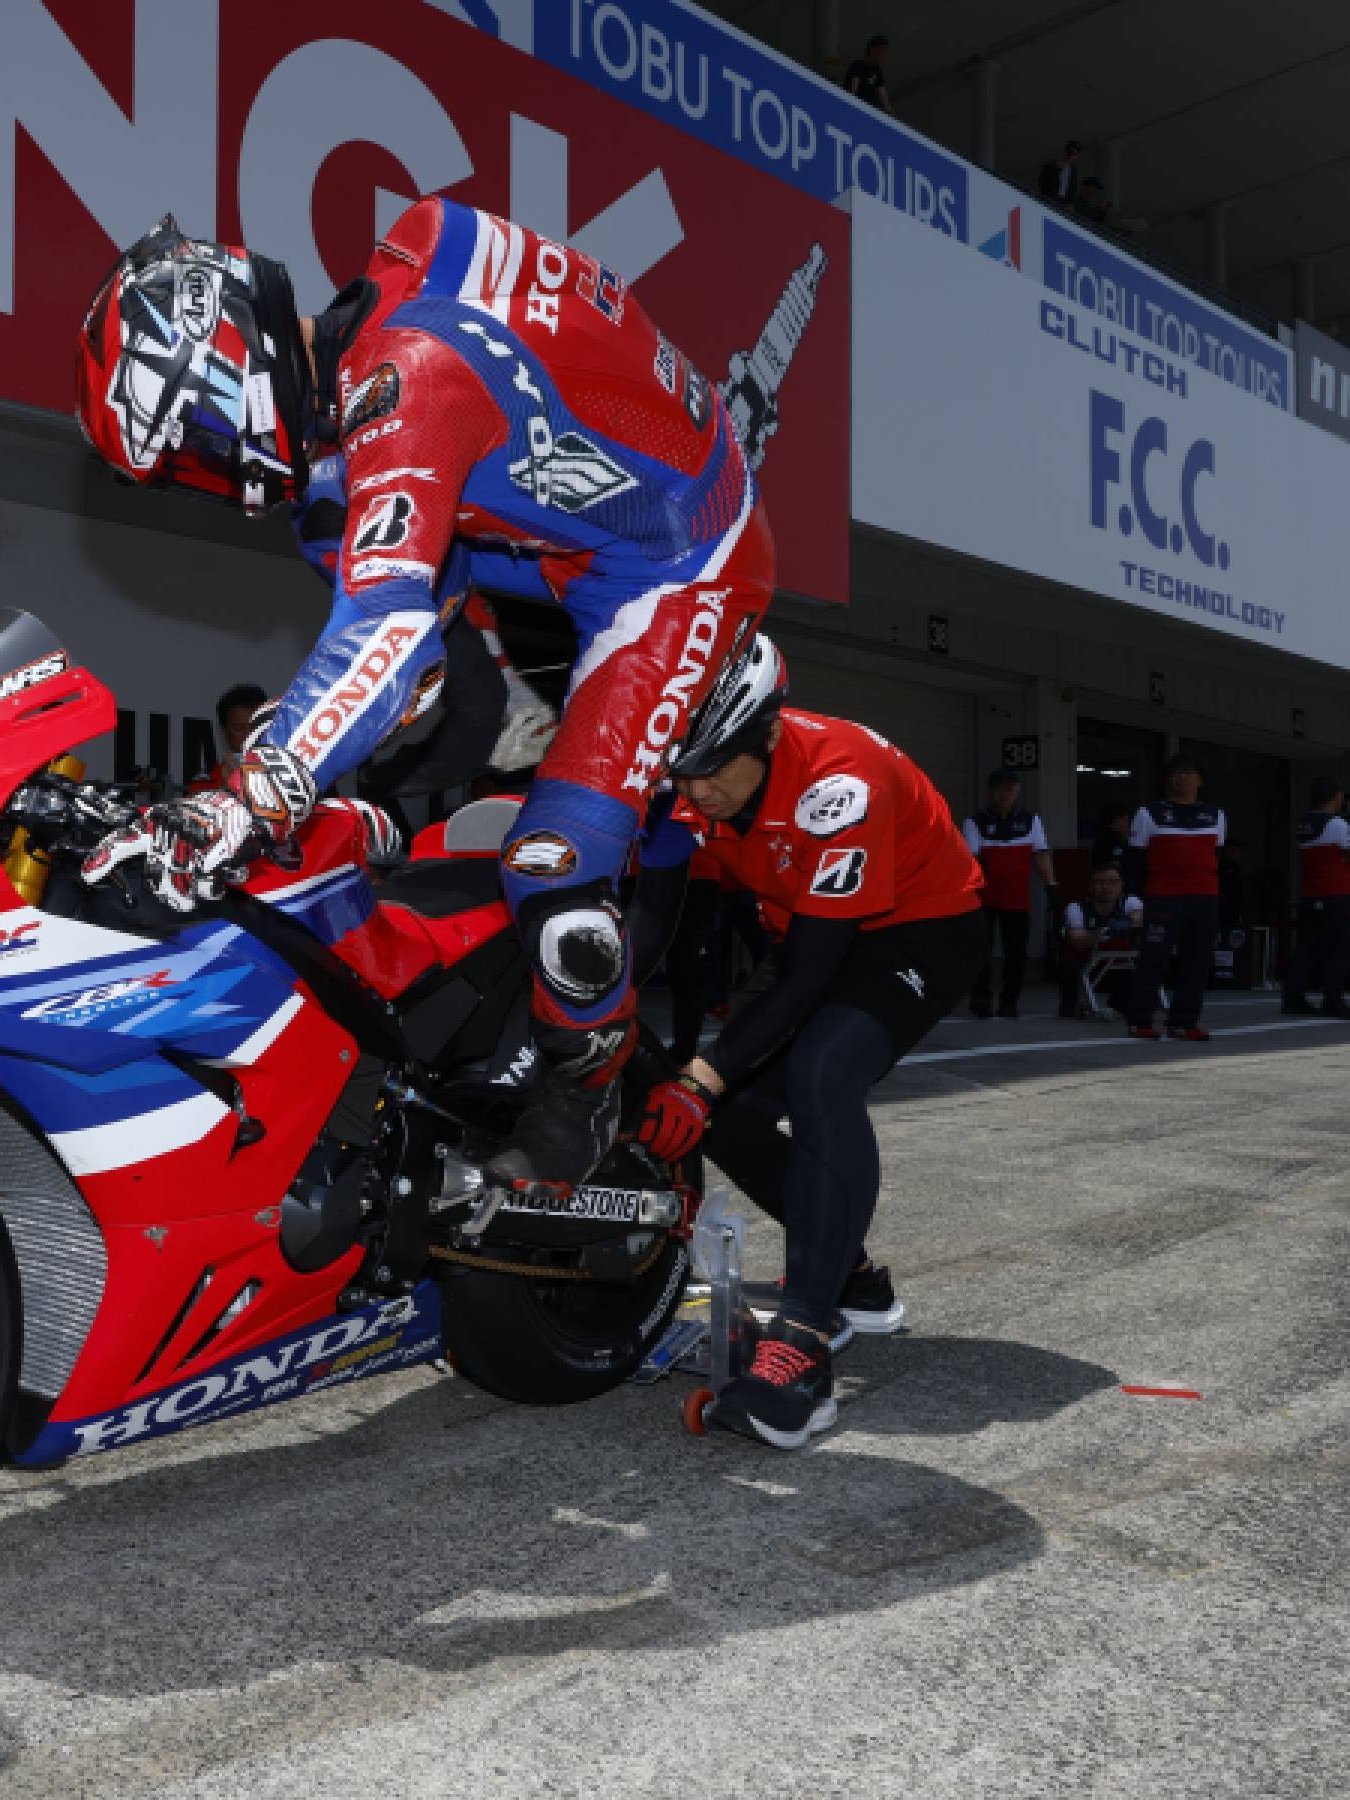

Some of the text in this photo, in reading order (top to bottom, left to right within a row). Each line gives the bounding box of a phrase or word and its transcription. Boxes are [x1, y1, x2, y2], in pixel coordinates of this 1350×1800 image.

[566, 0, 955, 238] TOBU TOP TOURS
[1040, 300, 1189, 400] CLUTCH
[1089, 387, 1230, 571] F.C.C.
[1119, 560, 1286, 634] TECHNOLOGY
[291, 625, 420, 763] HONDA
[621, 586, 732, 796] HONDA
[73, 1295, 420, 1456] HONDA
